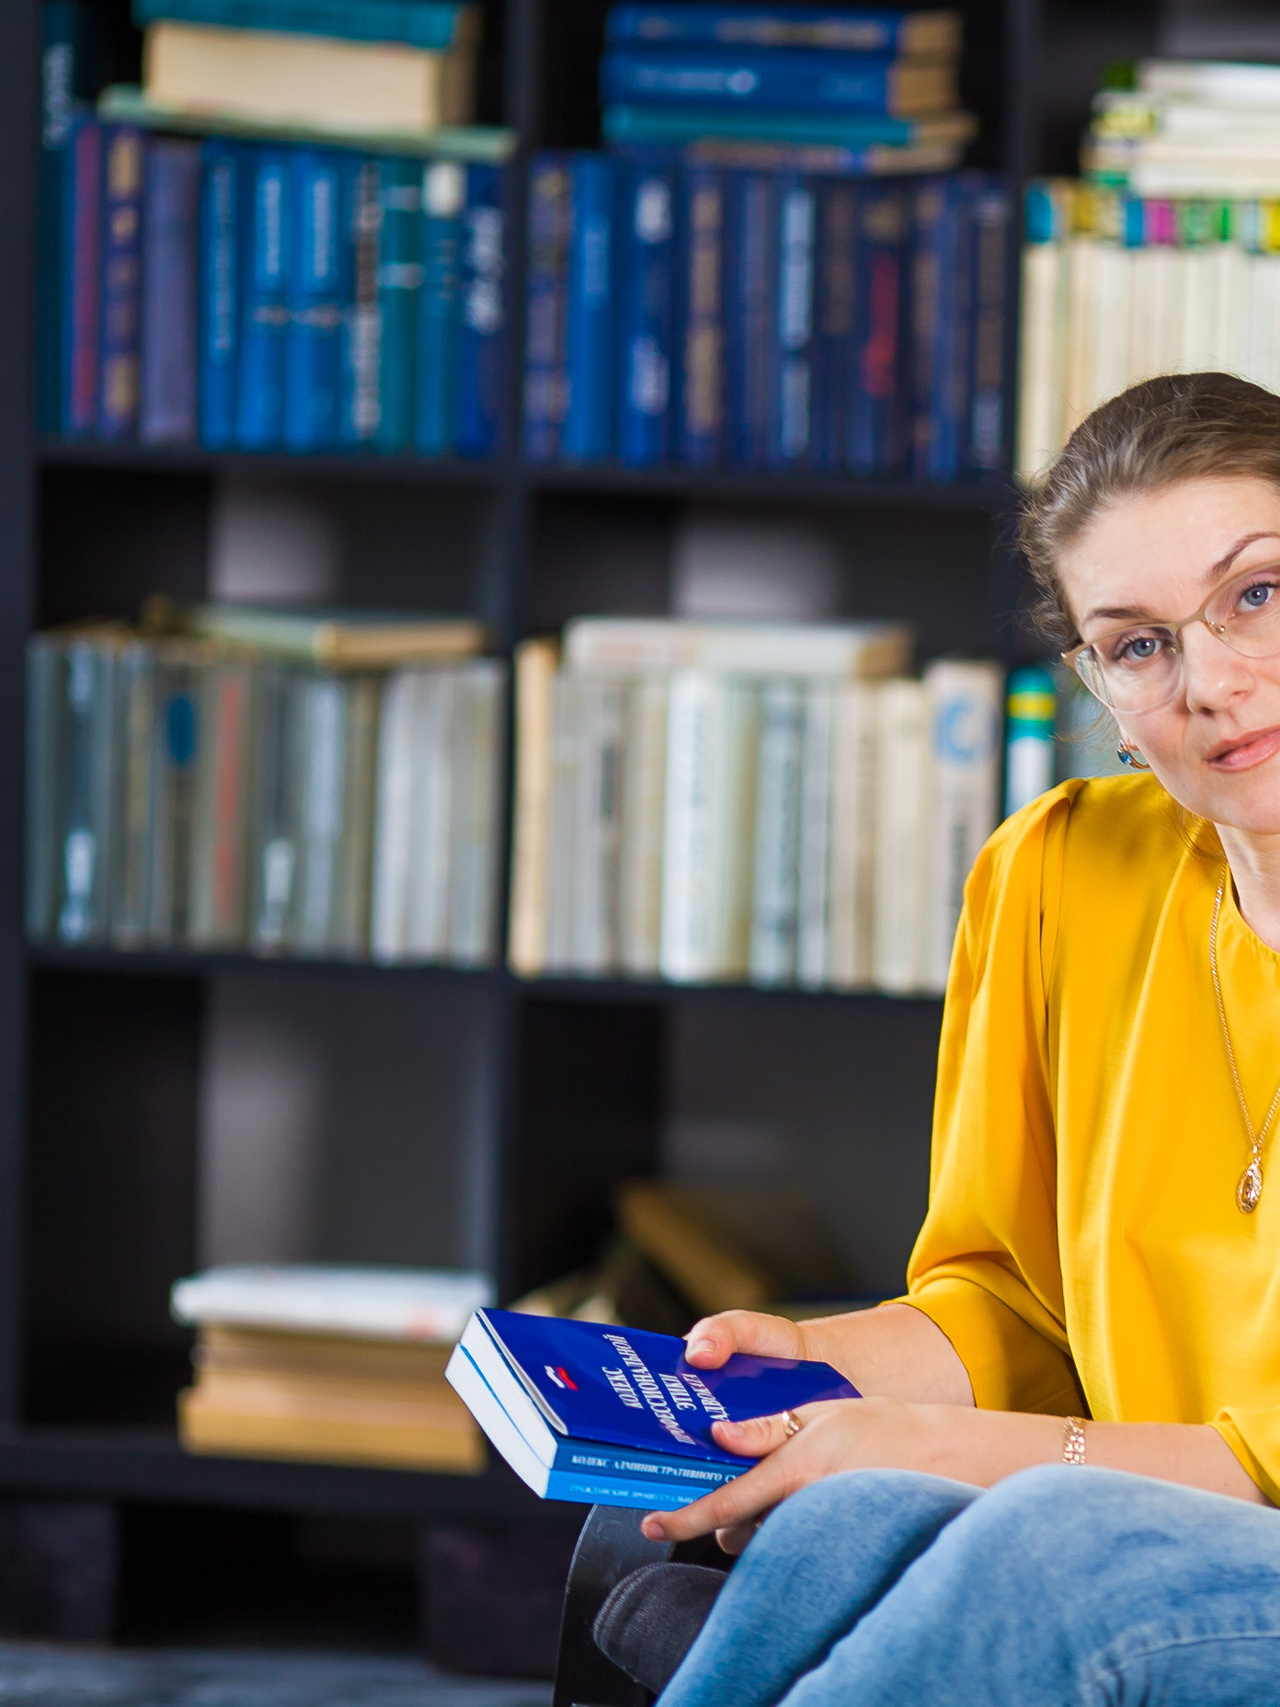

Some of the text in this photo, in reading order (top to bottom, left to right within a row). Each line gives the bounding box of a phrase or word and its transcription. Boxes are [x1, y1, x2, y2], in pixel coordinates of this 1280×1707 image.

[601, 1366, 644, 1410] КОДЕКС
[602, 1333, 697, 1446] ПРОФЕССИОНАЛЬНОЙ
[658, 1373, 698, 1411] ЭТИКИ
[681, 1373, 731, 1422] АДВОКАТА
[571, 1454, 610, 1469] КОДЕКС
[614, 1460, 723, 1483] АДМИНИСТРАТИВНОГО
